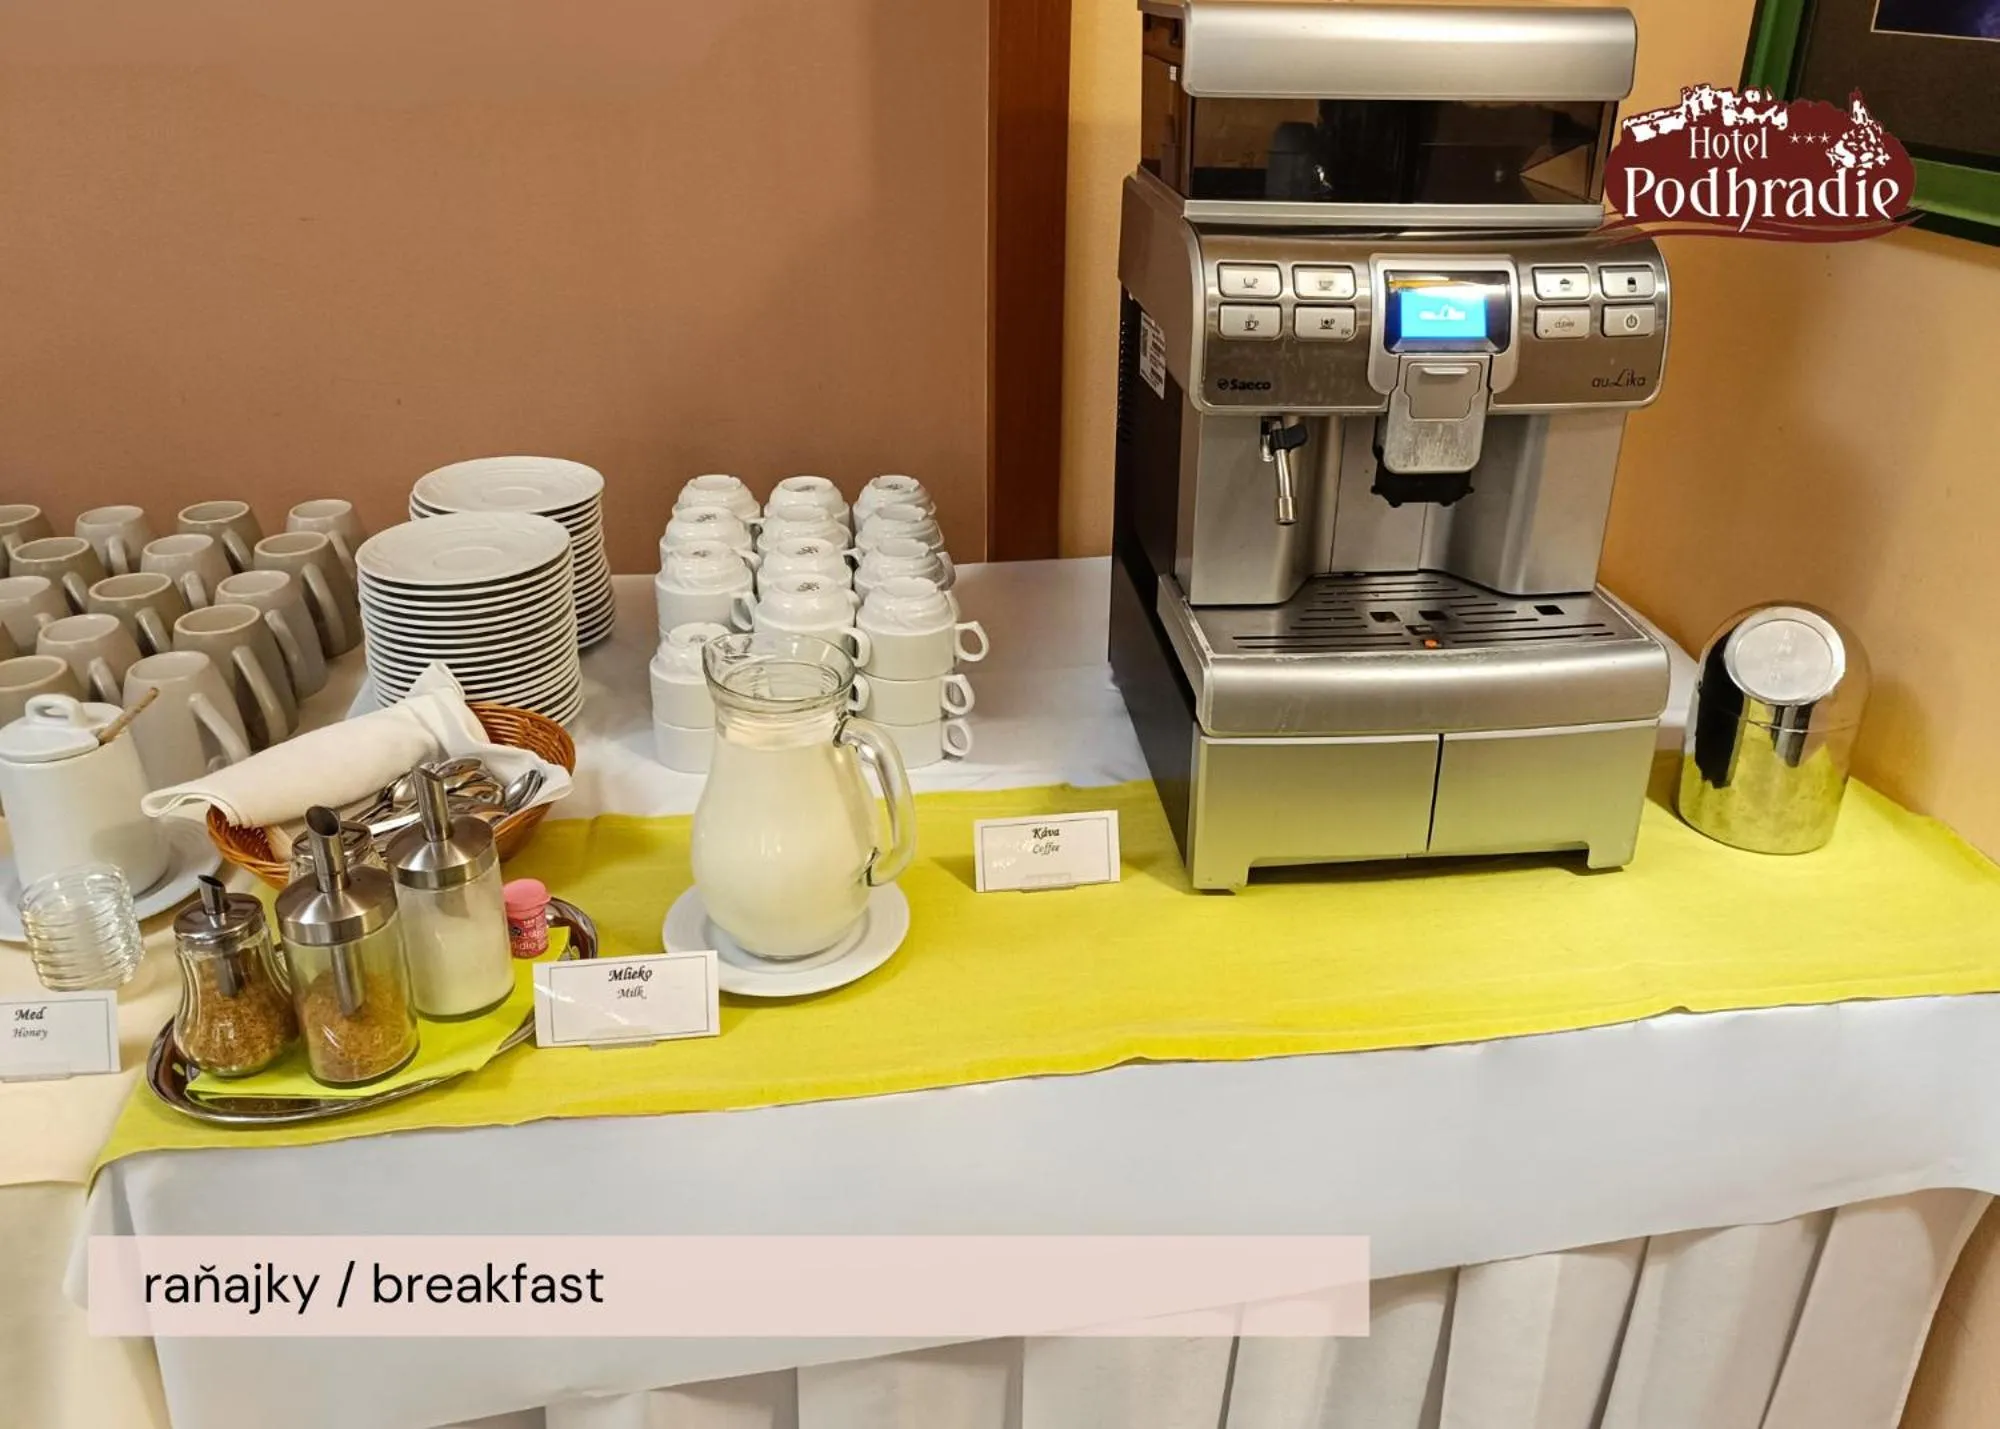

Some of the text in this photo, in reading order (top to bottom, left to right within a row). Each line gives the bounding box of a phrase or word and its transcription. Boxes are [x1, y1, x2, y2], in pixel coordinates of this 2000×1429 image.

[1032, 842, 1061, 856] Coffee
[608, 965, 653, 982] Mlieko
[616, 985, 647, 1000] Milk
[14, 1006, 47, 1021] Med
[12, 1027, 48, 1041] Honey
